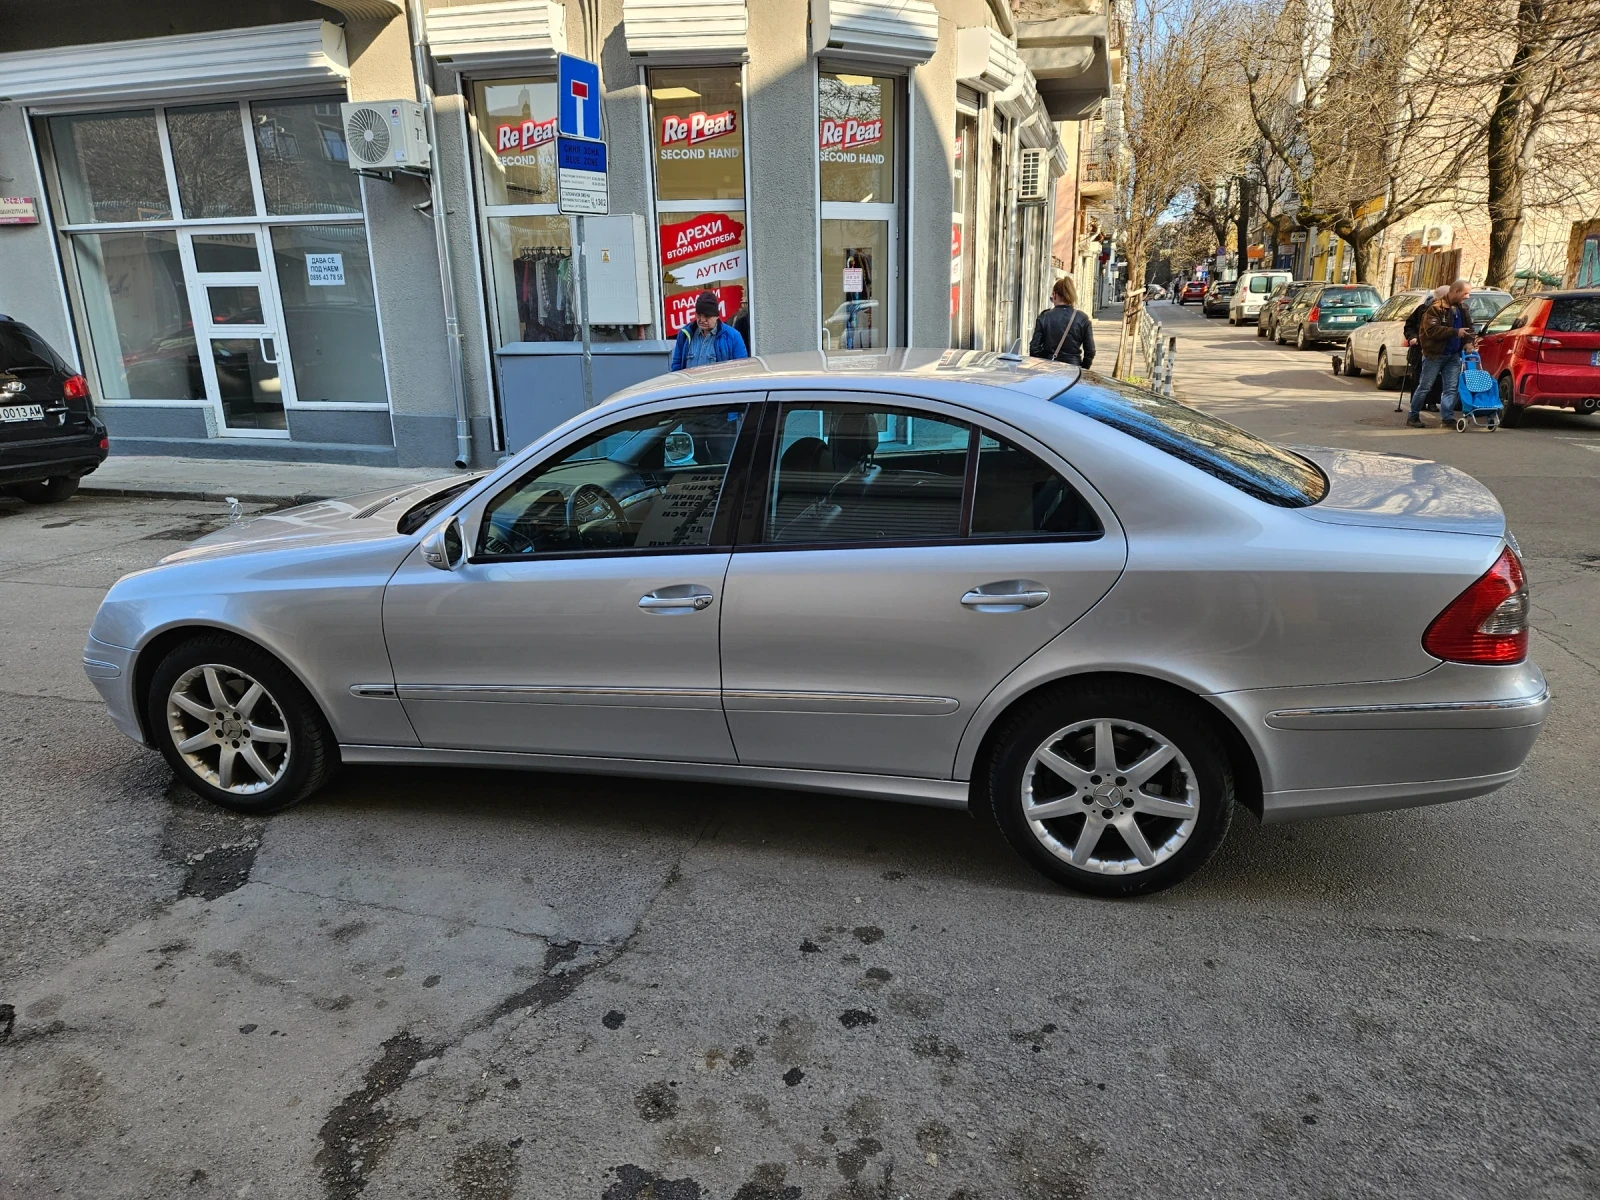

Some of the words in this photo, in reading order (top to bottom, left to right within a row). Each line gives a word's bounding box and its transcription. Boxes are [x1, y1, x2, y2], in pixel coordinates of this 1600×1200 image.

[563, 144, 581, 154] СИНЯ
[583, 147, 600, 156] ЗОНА
[660, 149, 705, 160] SECOND
[708, 147, 739, 159] HAND
[497, 154, 536, 166] SECOND
[565, 155, 581, 164] BLUE
[583, 157, 599, 166] ZONE
[820, 151, 857, 163] SECOND
[859, 153, 885, 164] HAND
[676, 219, 723, 248] ДРЕХИ
[666, 244, 693, 259] ВТОРА
[694, 232, 736, 253] УПОТРЕБА
[311, 257, 327, 265] ДАВА
[310, 265, 323, 273] ПОД
[696, 256, 741, 279] АУТЛЕТ
[670, 300, 727, 330] ЦЕИ
[3, 407, 27, 418] 0013
[30, 407, 42, 417] AM
